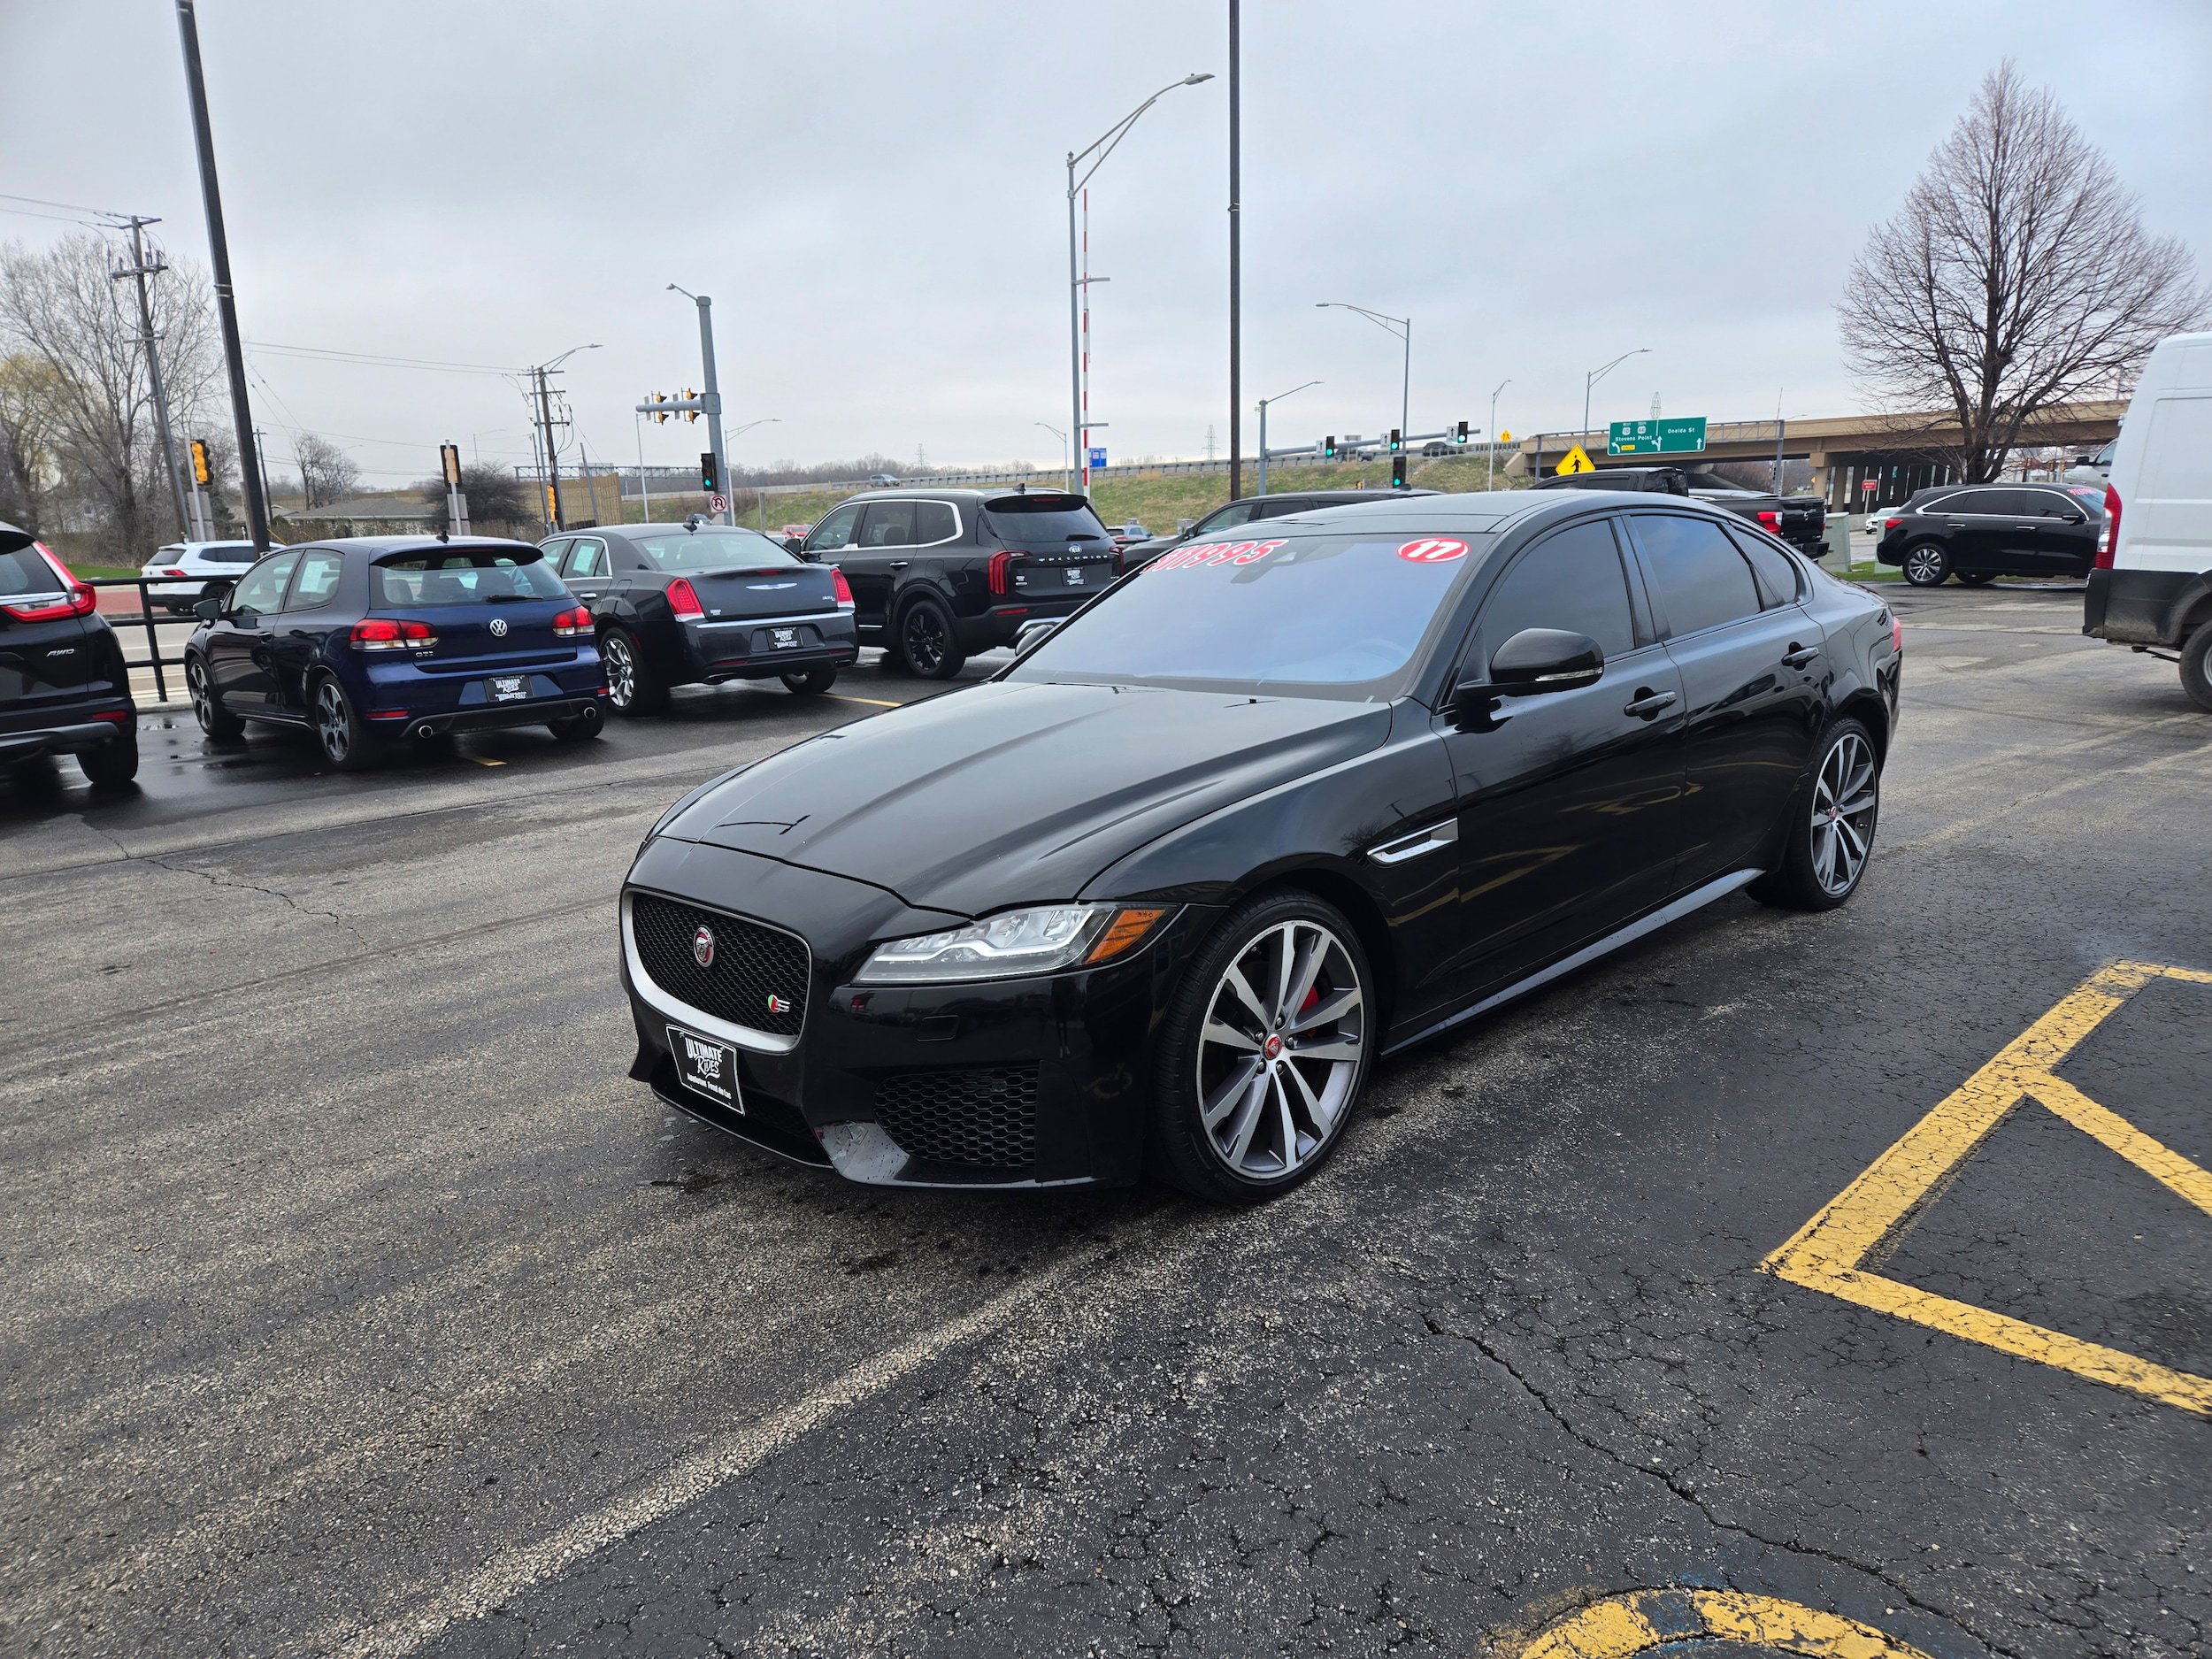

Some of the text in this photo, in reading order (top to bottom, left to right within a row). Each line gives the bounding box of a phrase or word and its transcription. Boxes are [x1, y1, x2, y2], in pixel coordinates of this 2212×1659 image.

[1407, 540, 1463, 560] 17
[46, 649, 75, 657] AWD
[685, 1037, 723, 1063] ULTIMATE
[695, 1055, 721, 1079] RIDES
